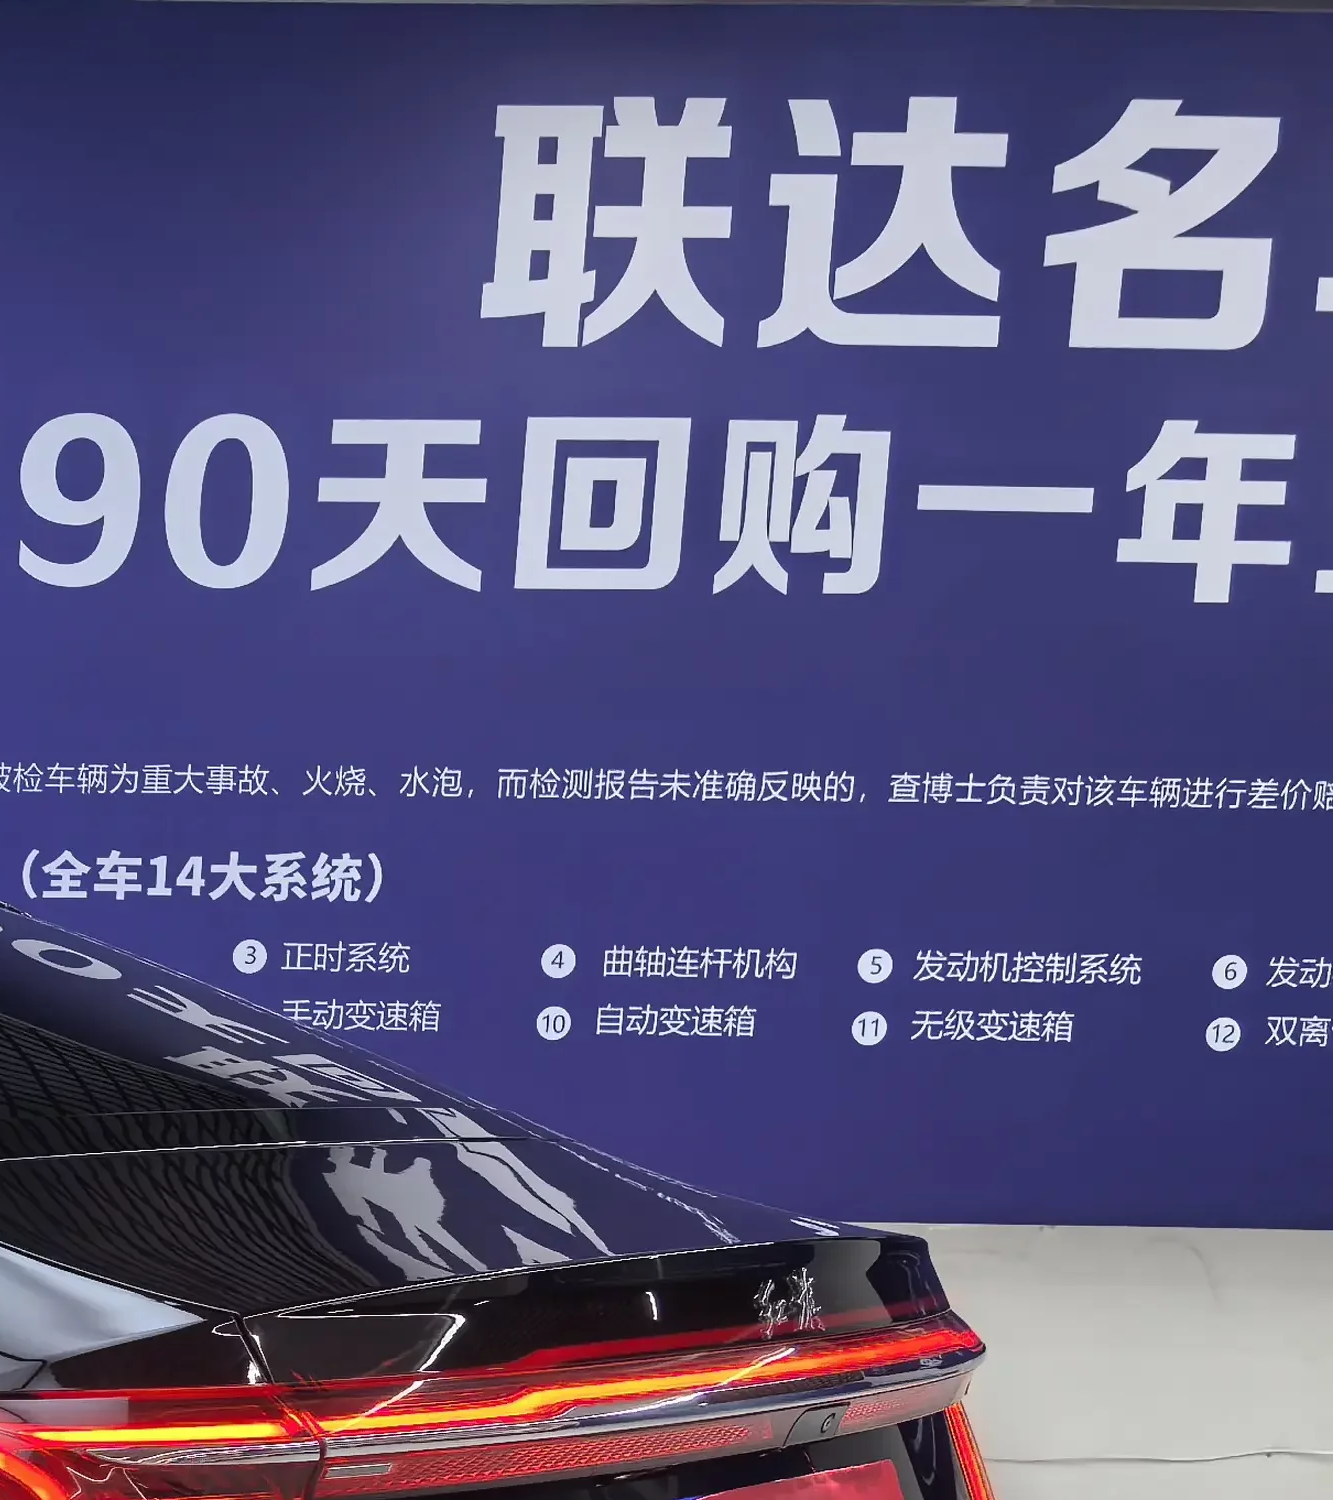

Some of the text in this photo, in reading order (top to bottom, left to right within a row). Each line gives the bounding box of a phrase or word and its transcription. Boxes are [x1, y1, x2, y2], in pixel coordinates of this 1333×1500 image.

[480, 96, 1333, 350] 联达名
[281, 941, 410, 973] 正时系统
[603, 945, 797, 979] 曲轴连杆机构
[913, 950, 1142, 985] 发动机控制系统
[1266, 956, 1333, 988] 发动
[282, 999, 441, 1032] 手动变速箱
[596, 1003, 757, 1037] 自动变速箱
[911, 1009, 1074, 1042] 无级变速箱
[1265, 1015, 1333, 1046] 双离
